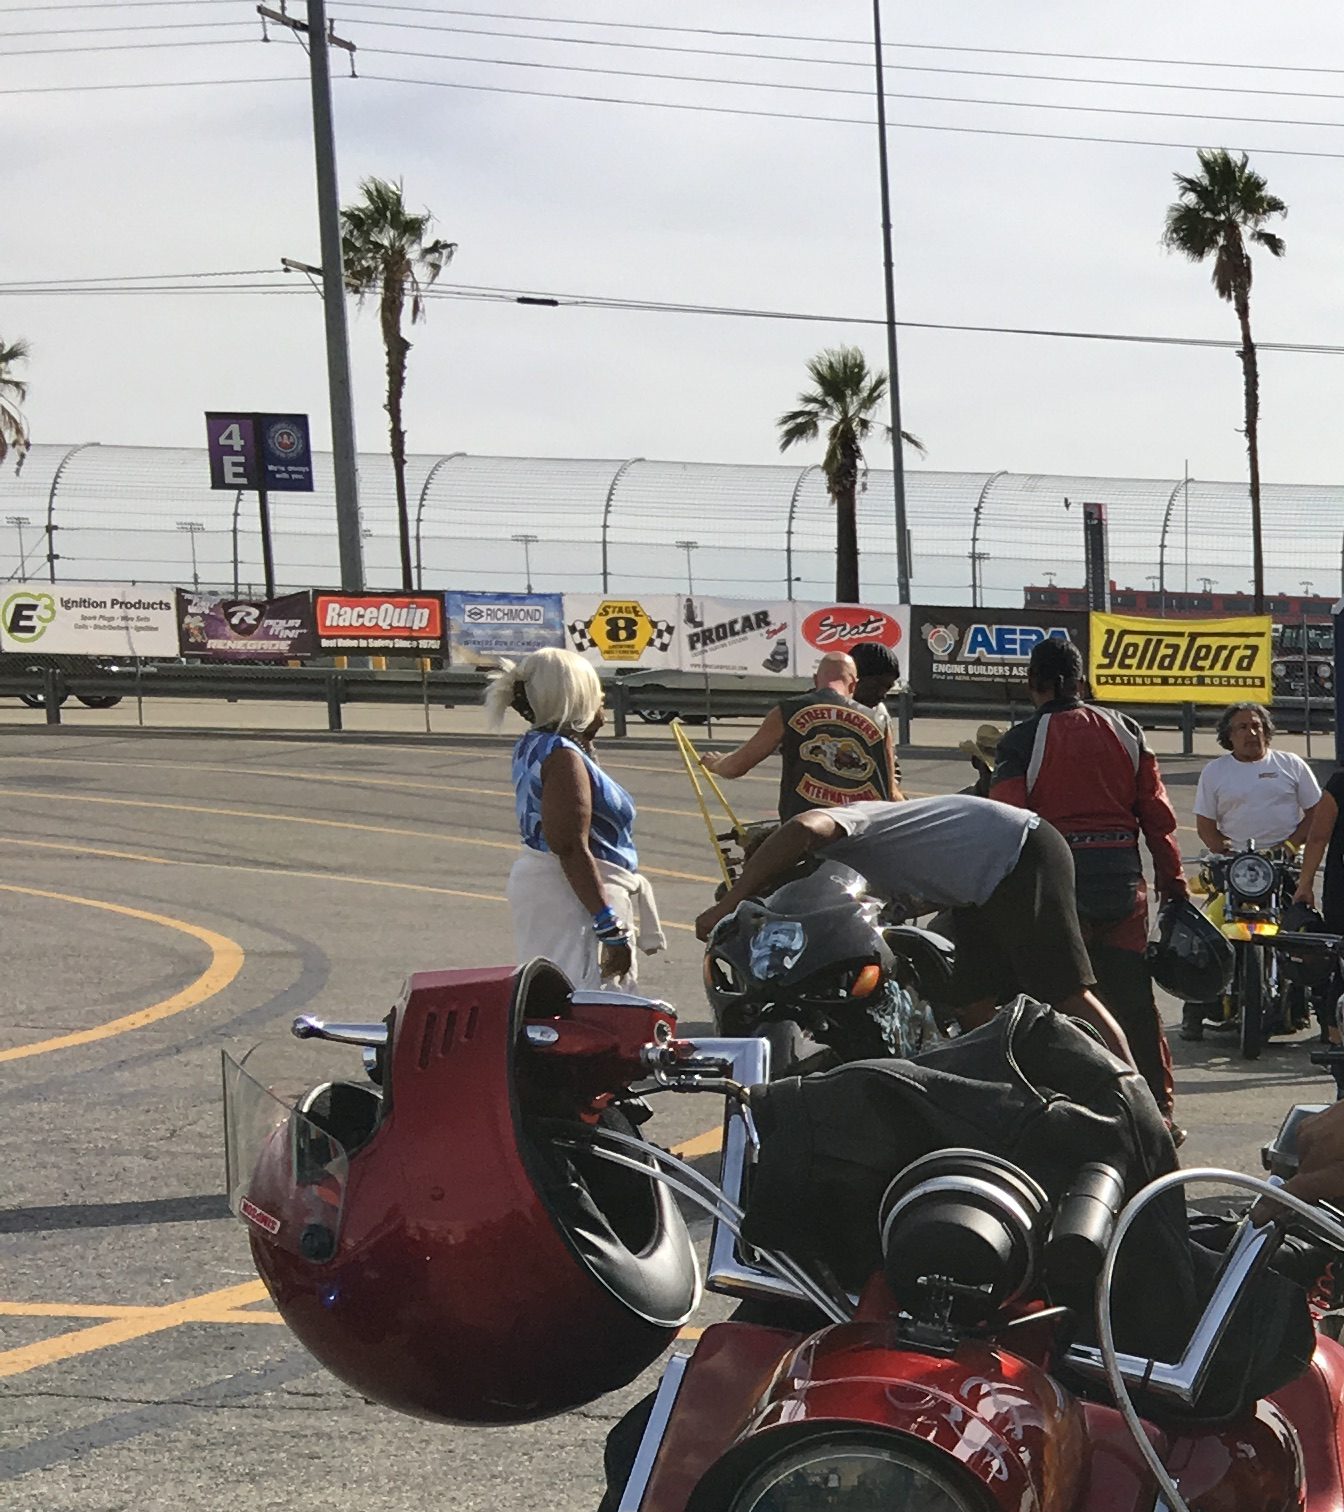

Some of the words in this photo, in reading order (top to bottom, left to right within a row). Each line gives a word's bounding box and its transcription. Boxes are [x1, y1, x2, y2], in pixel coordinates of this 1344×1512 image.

[218, 423, 245, 451] 4
[222, 455, 249, 484] E
[60, 597, 107, 611] Ignition
[110, 598, 172, 611] Products
[599, 604, 643, 618] STAGE
[325, 602, 430, 630] RaceQuip
[485, 607, 542, 622] RICHMOND
[605, 616, 639, 643] 8
[686, 610, 772, 652] PROCAR
[206, 639, 292, 650] RENEGADE
[320, 639, 337, 648] Best
[337, 639, 358, 648] Value
[368, 639, 393, 648] Safety
[394, 640, 417, 648] Since
[932, 662, 966, 674] ENGINE
[967, 663, 1010, 676] BUILDERS
[1100, 676, 1162, 684] PLATINUM
[1204, 678, 1262, 686] ROCKERS
[795, 707, 834, 730] STREET
[836, 708, 878, 740] RACERS
